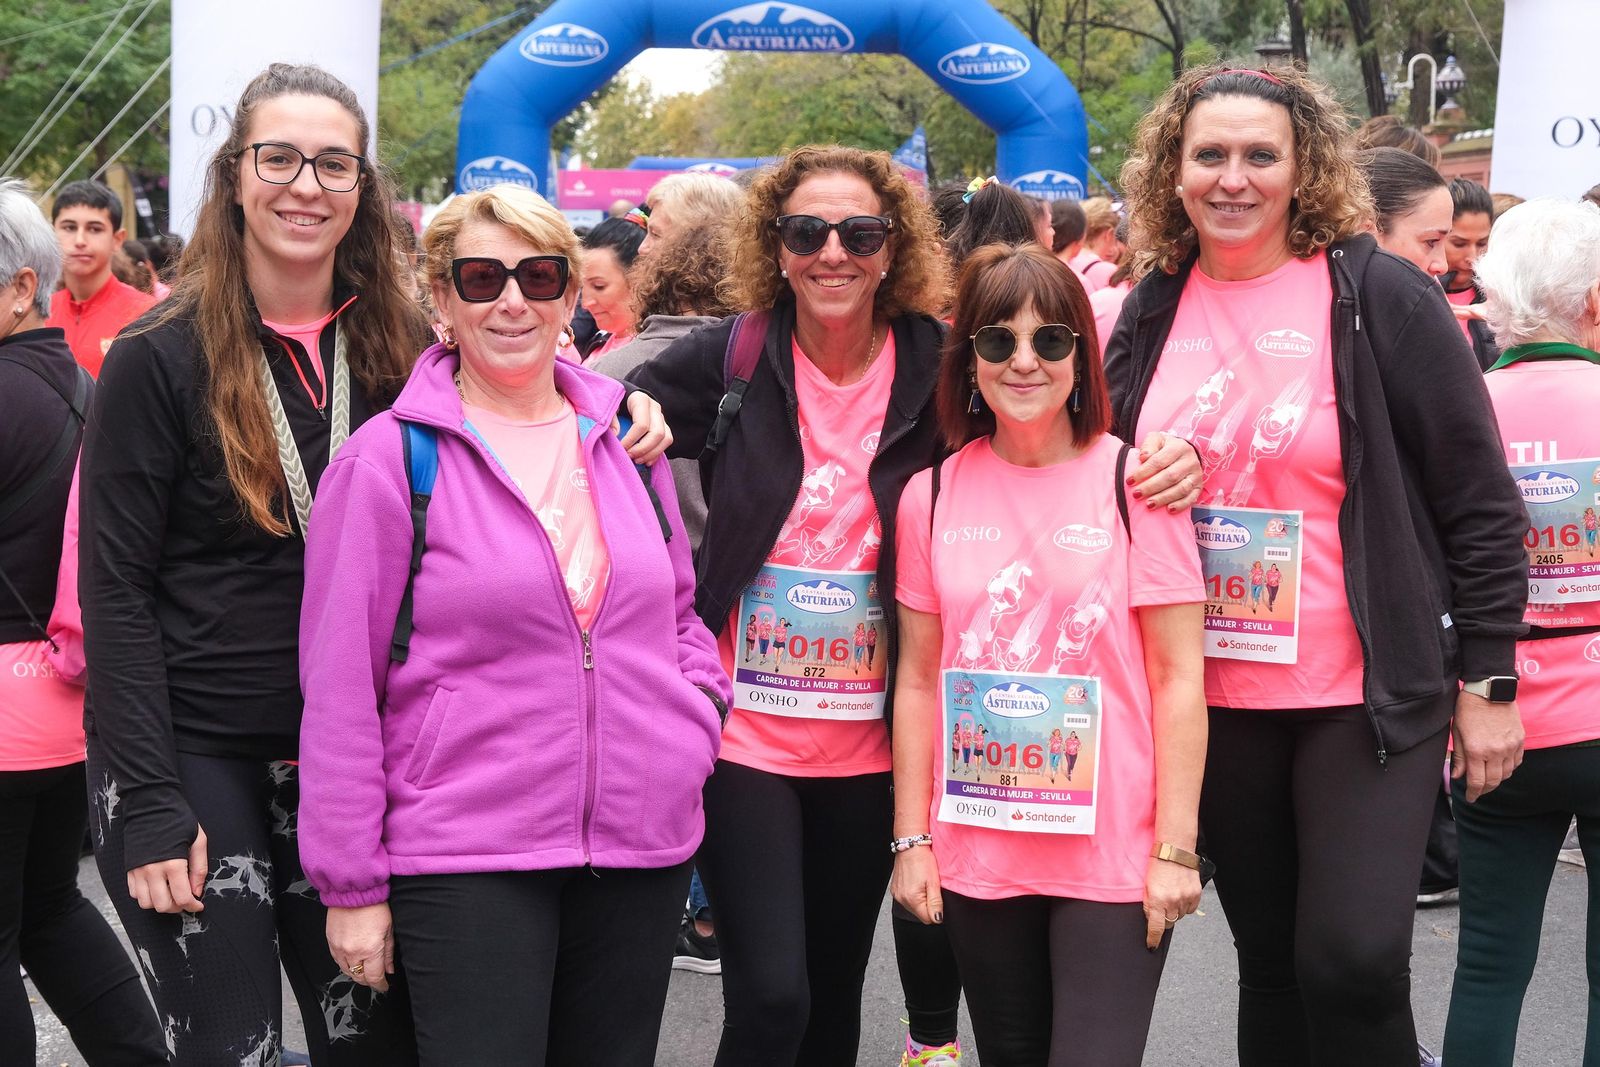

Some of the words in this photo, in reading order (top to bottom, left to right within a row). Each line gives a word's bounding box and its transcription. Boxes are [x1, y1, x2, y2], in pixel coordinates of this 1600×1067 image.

[706, 28, 842, 50] ASTURIANA
[945, 57, 1026, 75] ASTURIANA
[943, 527, 1001, 545] OSHO
[1523, 524, 1581, 549] 016
[1535, 554, 1564, 565] 2405
[1550, 566, 1576, 575] MUJER
[1582, 563, 1600, 572] SEVI
[1208, 574, 1246, 600] 16
[790, 589, 852, 607] ASTURIANA
[1212, 618, 1237, 629] MUJER
[1242, 621, 1273, 631] SEVILLA
[788, 635, 849, 662] 016
[1229, 640, 1278, 653] Santander
[803, 666, 826, 679] 872
[756, 674, 788, 687] CARRERA
[789, 679, 800, 688] DE
[801, 680, 811, 689] LA
[813, 681, 839, 690] MUJER
[844, 682, 872, 691] SEVILLA
[748, 690, 798, 708] OYSHO
[829, 700, 875, 711] Santander
[986, 693, 1046, 711] ASTURIANA
[986, 741, 1044, 769] 016
[1000, 774, 1018, 787] 881
[962, 784, 989, 796] CARRERA
[990, 786, 998, 796] DE
[998, 787, 1007, 797] LA
[1007, 788, 1033, 799] MUJER
[1040, 790, 1072, 801] SEVILLA
[956, 802, 997, 818] OYSHO
[1025, 810, 1076, 824] Santander
